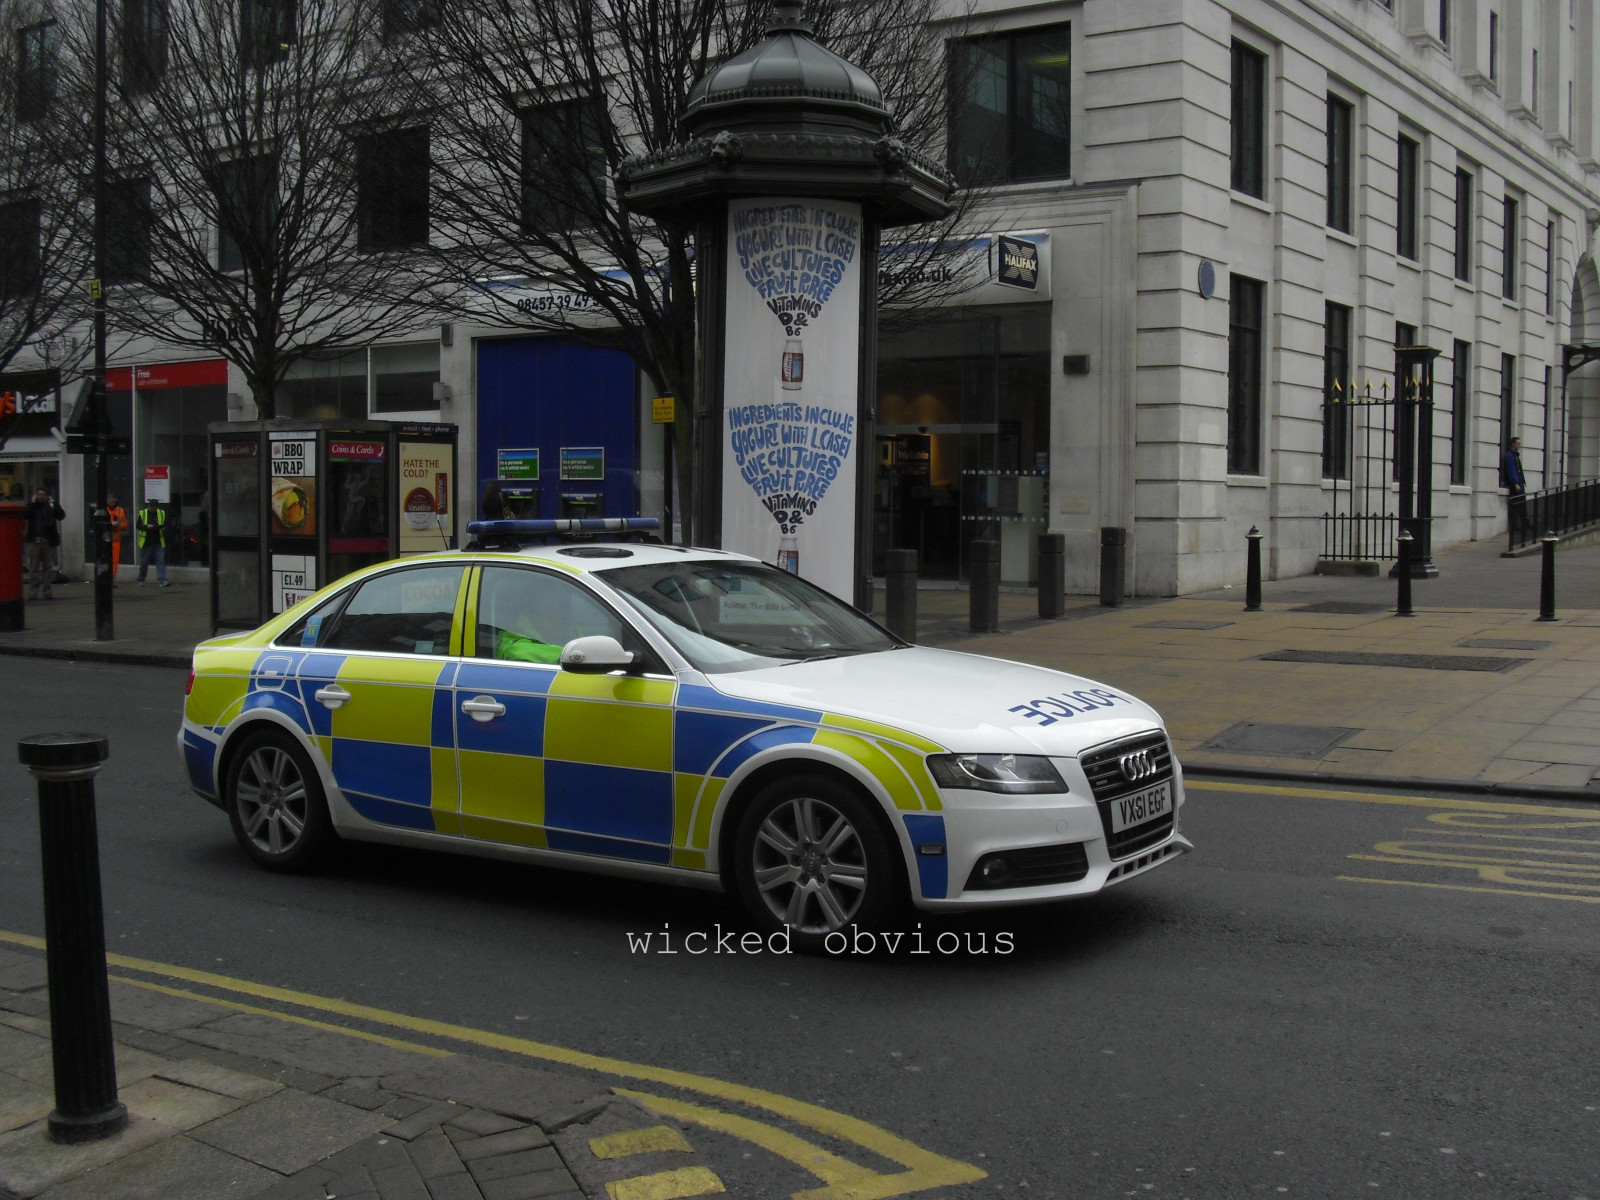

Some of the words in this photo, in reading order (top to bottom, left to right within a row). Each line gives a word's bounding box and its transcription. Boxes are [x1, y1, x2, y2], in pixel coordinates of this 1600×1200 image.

[736, 225, 784, 269] YOGURT
[1004, 253, 1038, 272] HALIFAX
[745, 255, 775, 288] LIVE
[90, 281, 99, 296] H
[517, 297, 553, 312] 08457
[556, 295, 570, 309] 39
[778, 312, 793, 326] D
[793, 312, 808, 327] &
[137, 369, 151, 378] Free
[284, 443, 303, 457] BBQ
[331, 444, 350, 454] Coins
[350, 445, 356, 454] &
[356, 445, 374, 454] Cards
[731, 423, 779, 467] YOGURT
[273, 461, 303, 475] WRAP
[403, 459, 423, 468] HATE
[424, 459, 440, 468] THE
[740, 453, 770, 485] LIVE
[403, 469, 429, 478] COLD?
[407, 503, 432, 512] Vaseline
[773, 510, 788, 524] D
[788, 510, 804, 524] &
[284, 574, 303, 586] £1.49
[1148, 786, 1166, 815] EGF
